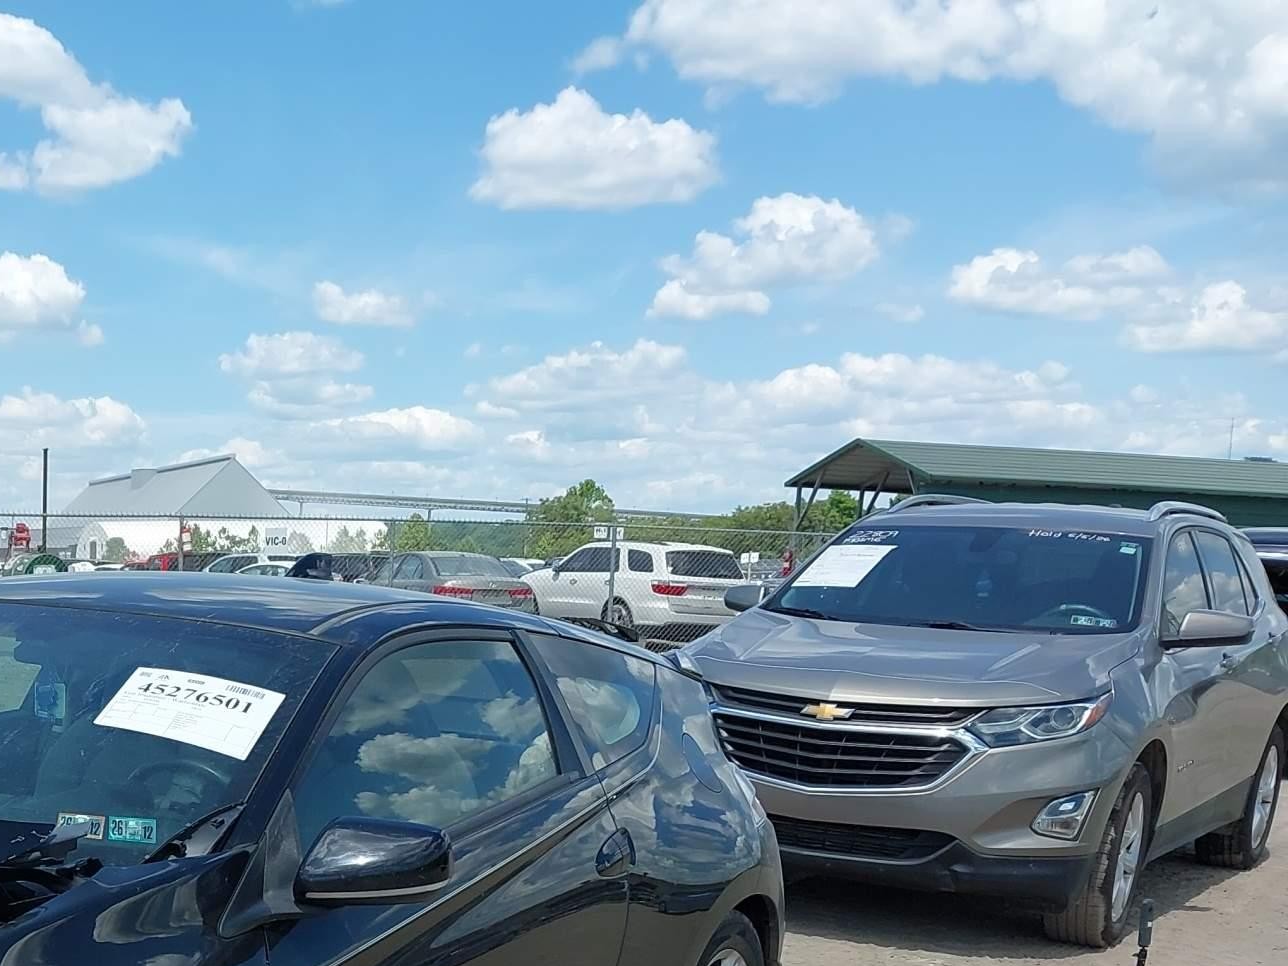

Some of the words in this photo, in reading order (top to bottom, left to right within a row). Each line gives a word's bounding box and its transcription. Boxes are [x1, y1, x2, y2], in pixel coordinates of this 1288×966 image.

[1028, 529, 1062, 538] Hold
[138, 682, 253, 714] 45276501
[89, 820, 101, 836] 12
[111, 819, 123, 836] 26
[142, 825, 154, 840] 12
